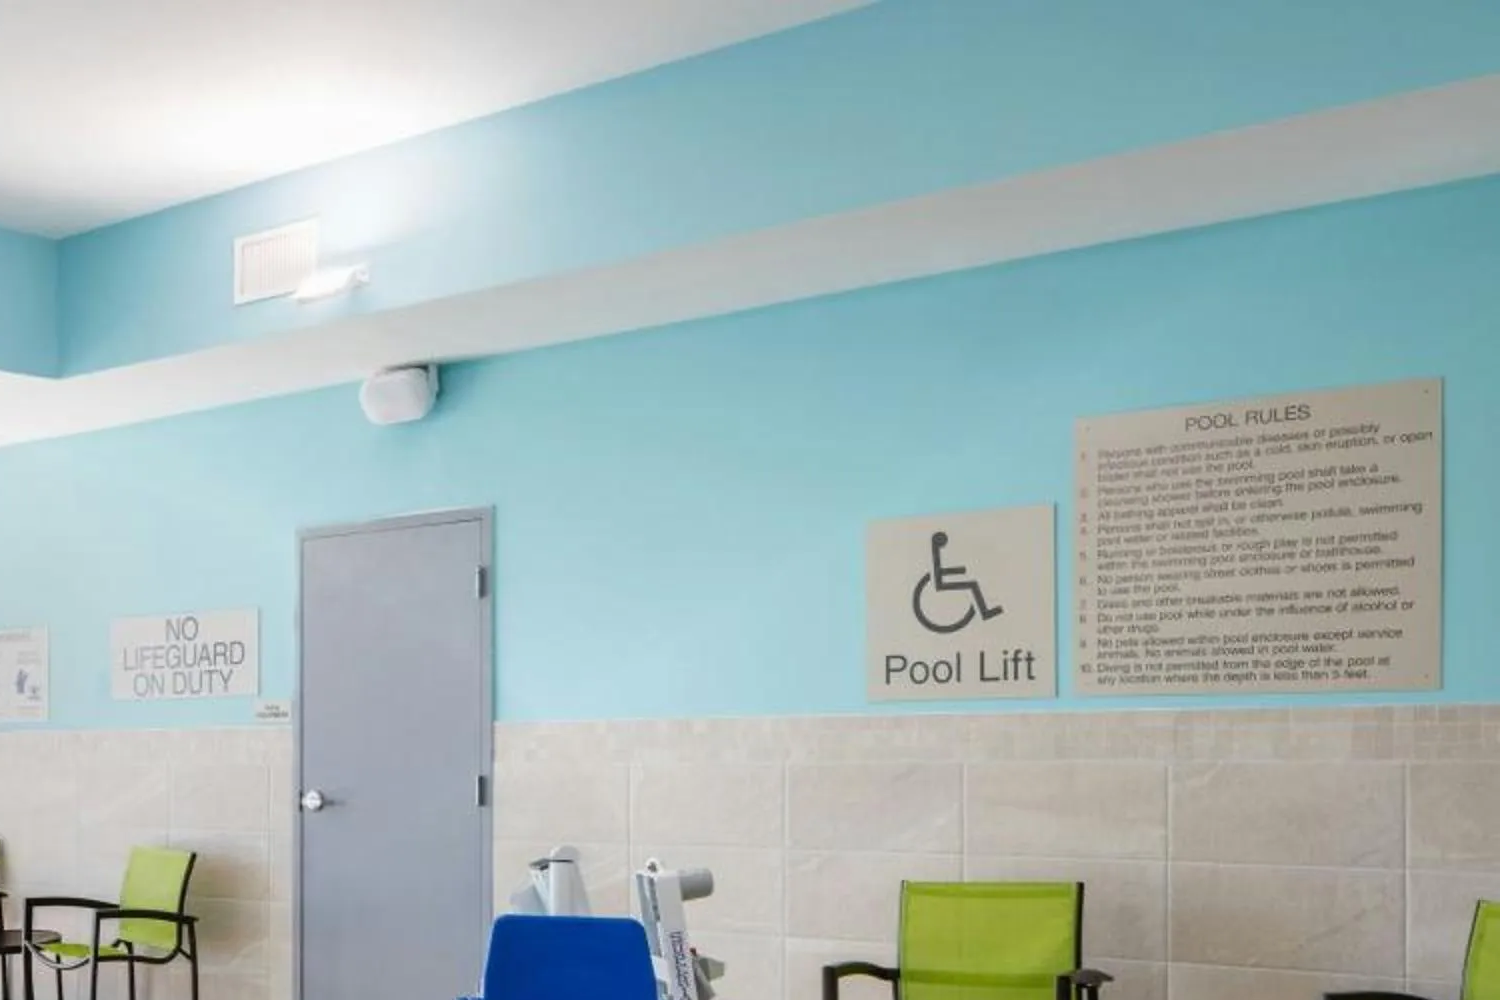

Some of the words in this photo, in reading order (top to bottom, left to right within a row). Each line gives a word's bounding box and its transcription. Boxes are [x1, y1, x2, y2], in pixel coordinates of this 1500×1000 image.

[1185, 413, 1239, 431] POOL
[1245, 404, 1311, 424] RULES
[165, 616, 199, 641] NO
[123, 641, 245, 671] LIFEGUARD
[885, 652, 961, 686] Pool
[979, 649, 1035, 682] Lift
[133, 673, 165, 697] ON
[173, 669, 233, 695] DUTY
